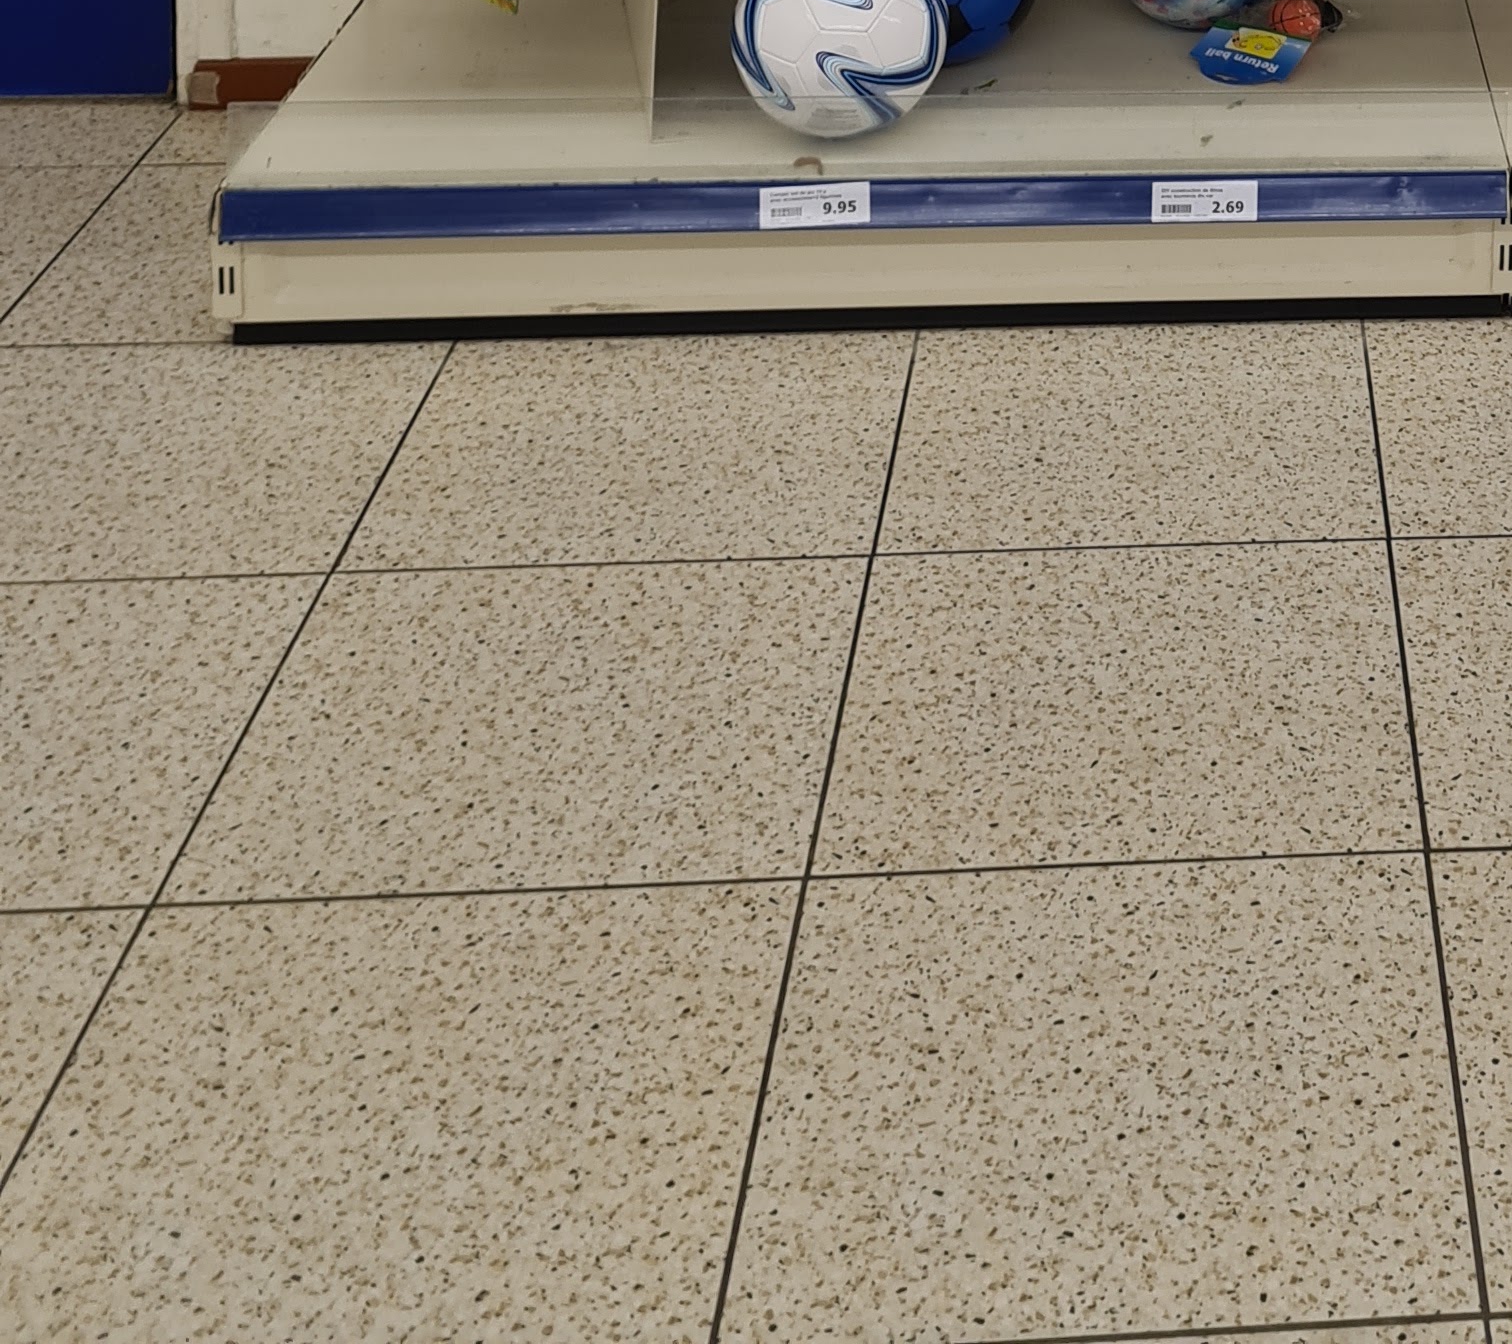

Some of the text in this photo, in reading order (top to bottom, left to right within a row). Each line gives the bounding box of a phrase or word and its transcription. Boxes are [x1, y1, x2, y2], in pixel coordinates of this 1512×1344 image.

[1205, 46, 1280, 74] Return ball
[822, 200, 857, 215] 9.95
[1212, 200, 1244, 214] 2.69
